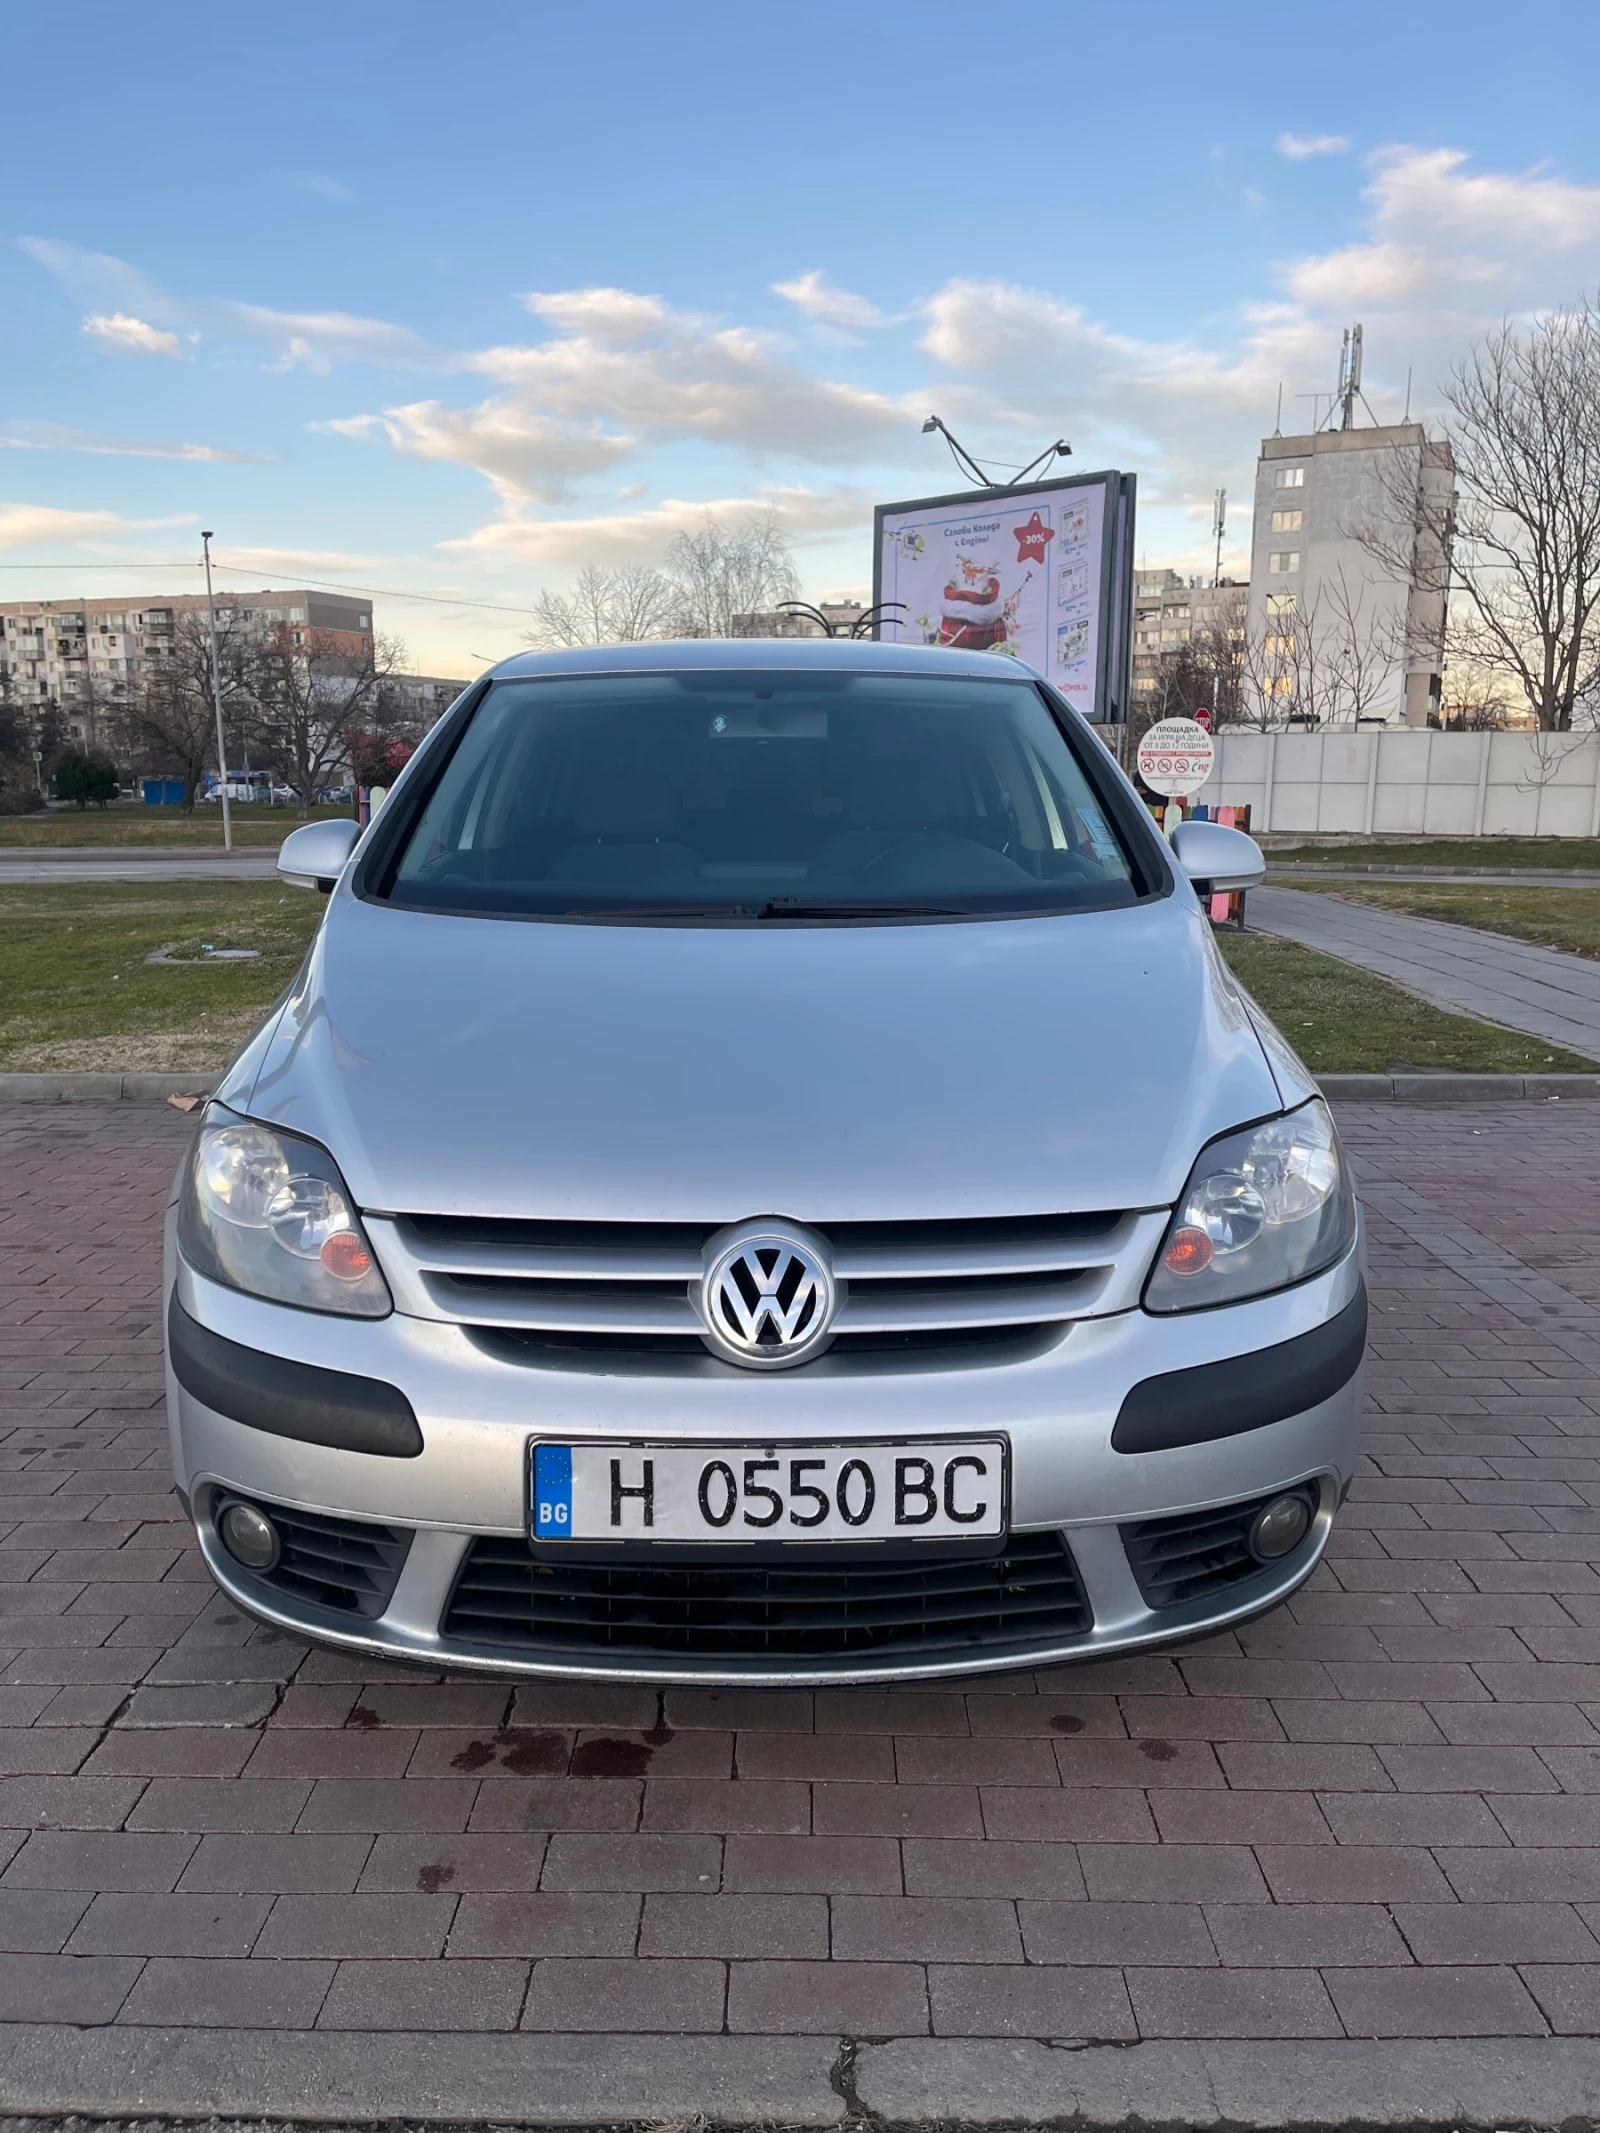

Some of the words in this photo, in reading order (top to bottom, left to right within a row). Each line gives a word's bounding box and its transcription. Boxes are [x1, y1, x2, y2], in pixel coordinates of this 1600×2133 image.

[1021, 532, 1045, 545] -30%
[610, 1459, 654, 1527] H
[698, 1458, 876, 1527] 0550
[894, 1457, 987, 1526] BC
[539, 1503, 568, 1524] BG
